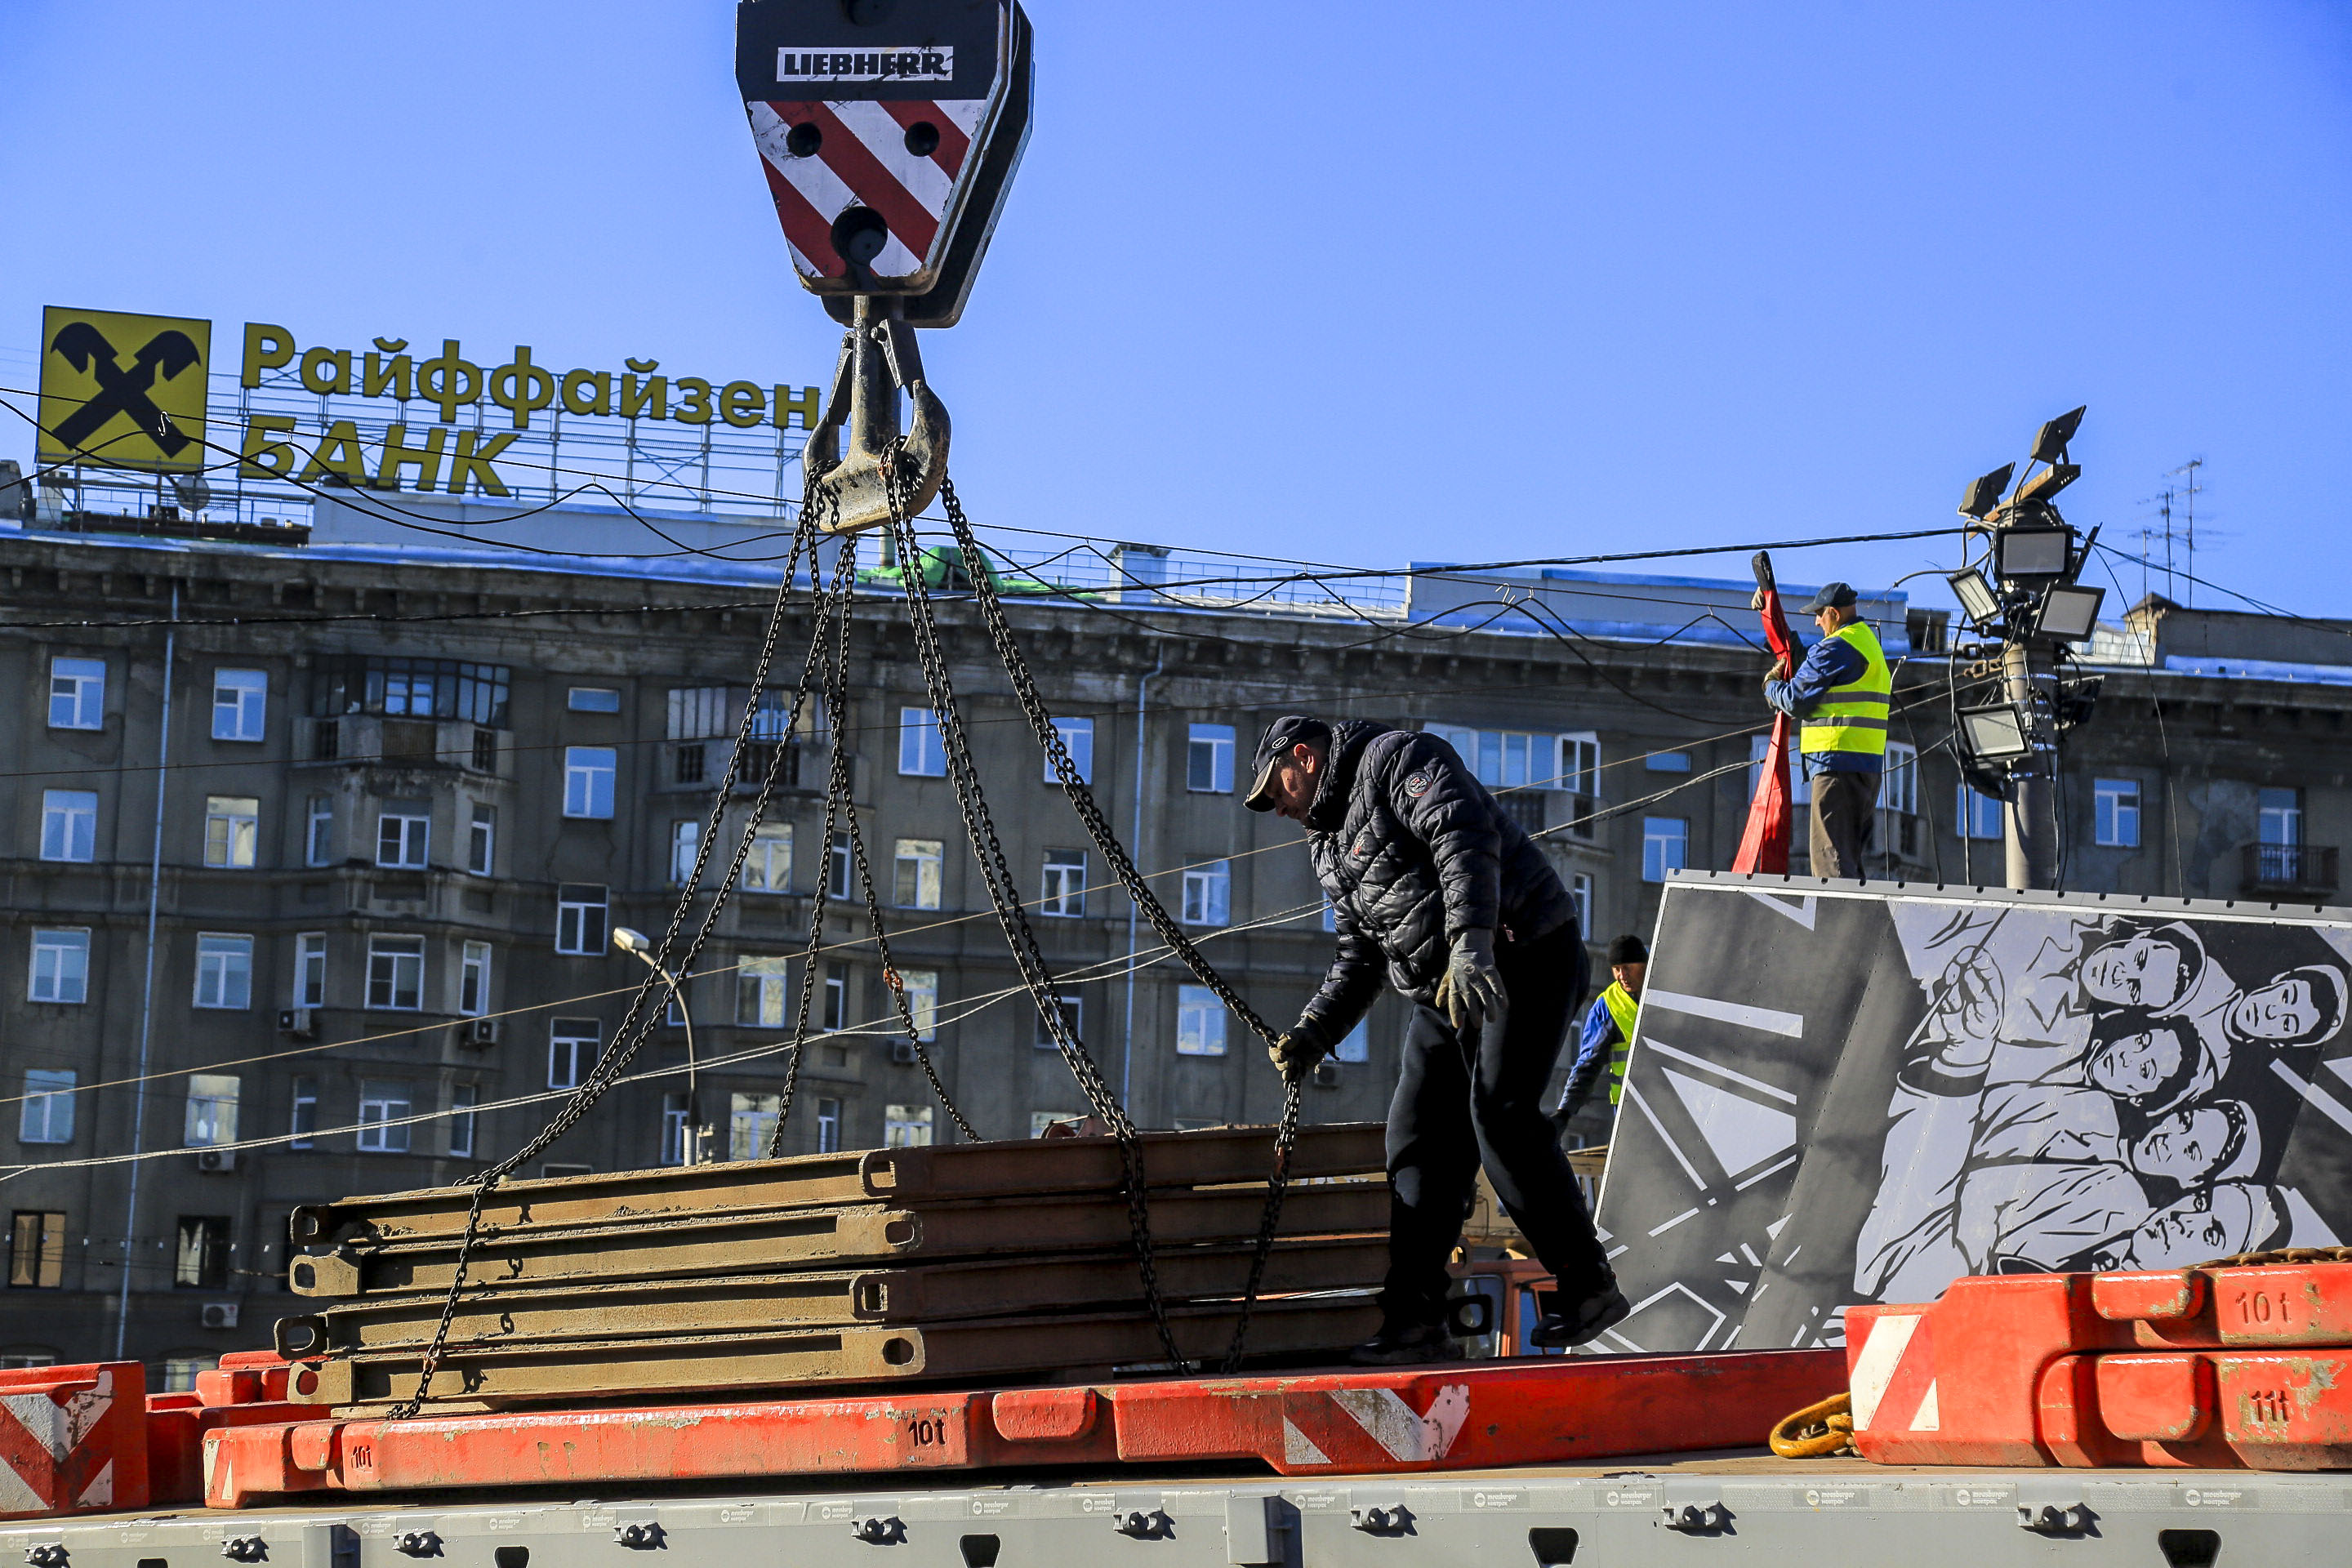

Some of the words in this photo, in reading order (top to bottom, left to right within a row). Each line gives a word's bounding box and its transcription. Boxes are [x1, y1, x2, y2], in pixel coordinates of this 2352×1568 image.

[783, 52, 946, 76] LIEBHERR
[241, 321, 820, 431] Райффайзен
[238, 414, 521, 498] БАНК
